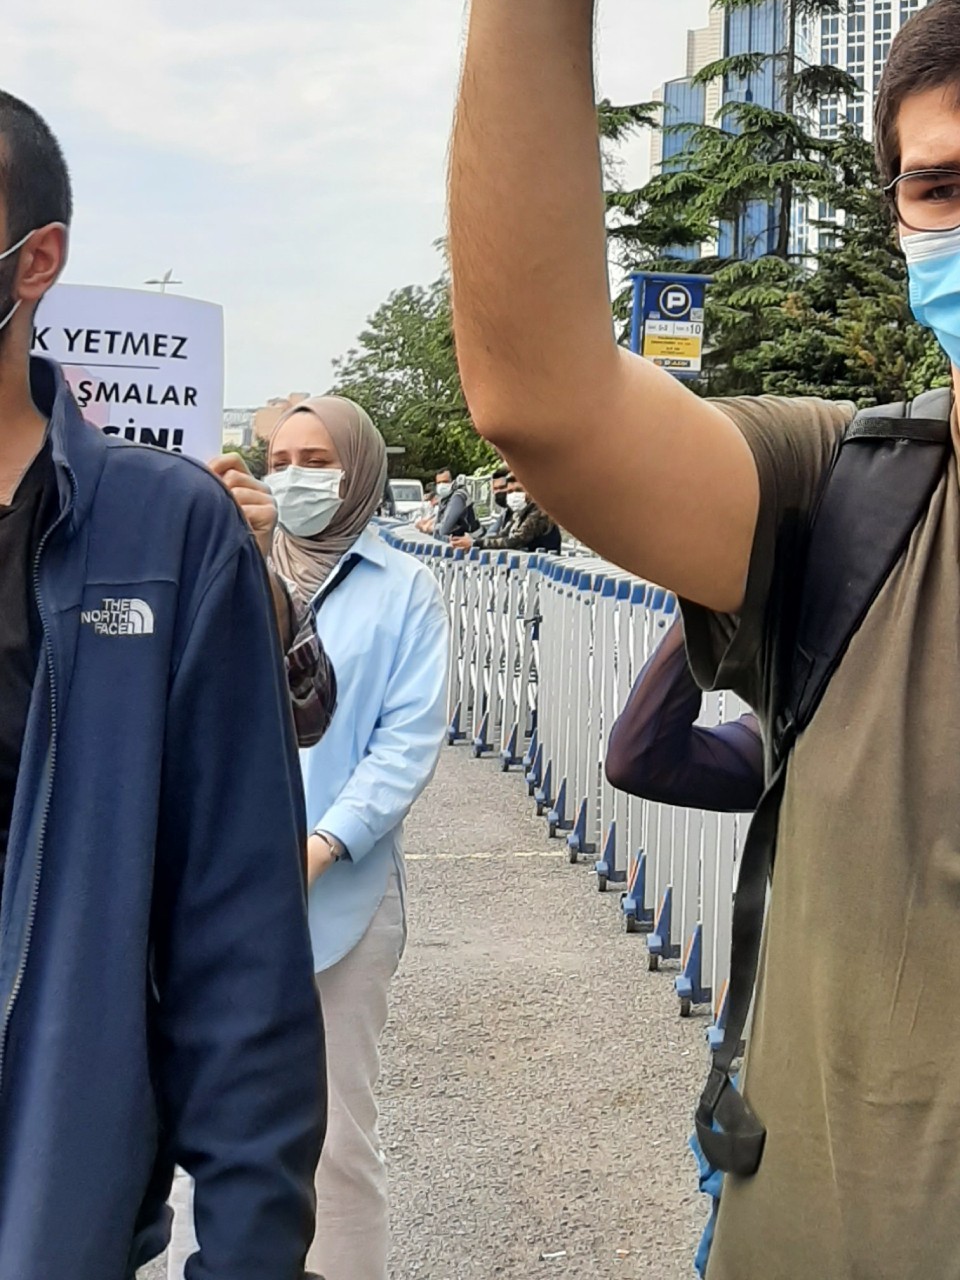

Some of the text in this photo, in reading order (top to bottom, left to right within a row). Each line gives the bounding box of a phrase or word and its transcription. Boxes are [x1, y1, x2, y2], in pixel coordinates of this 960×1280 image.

[63, 327, 188, 360] YETMEZ
[66, 379, 199, 408] ŞMALAR
[102, 598, 131, 611] THE
[81, 610, 129, 624] NORTH
[95, 622, 128, 635] FACE
